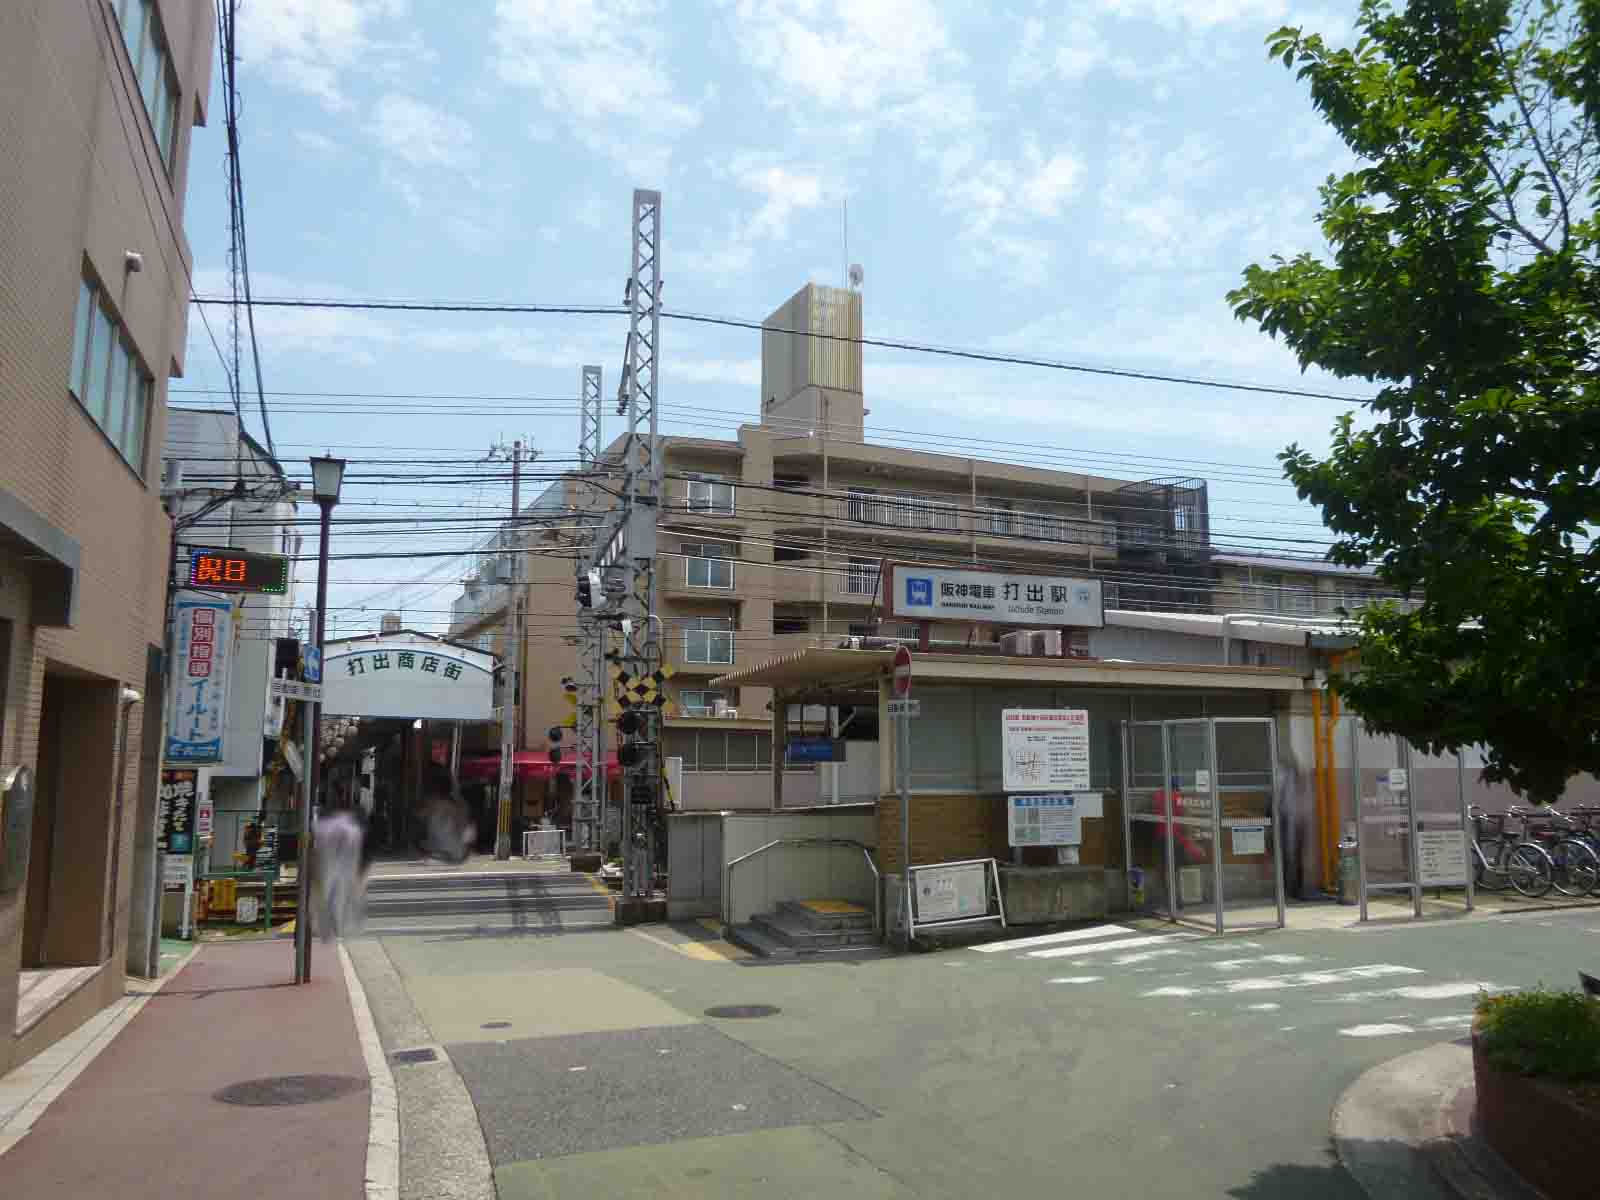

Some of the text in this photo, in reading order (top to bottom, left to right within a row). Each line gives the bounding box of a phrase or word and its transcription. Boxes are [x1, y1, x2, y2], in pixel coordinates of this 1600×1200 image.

[941, 583, 995, 599] 阪神電車
[1003, 581, 1068, 603] 打出駅
[345, 652, 463, 681] 打出商店街
